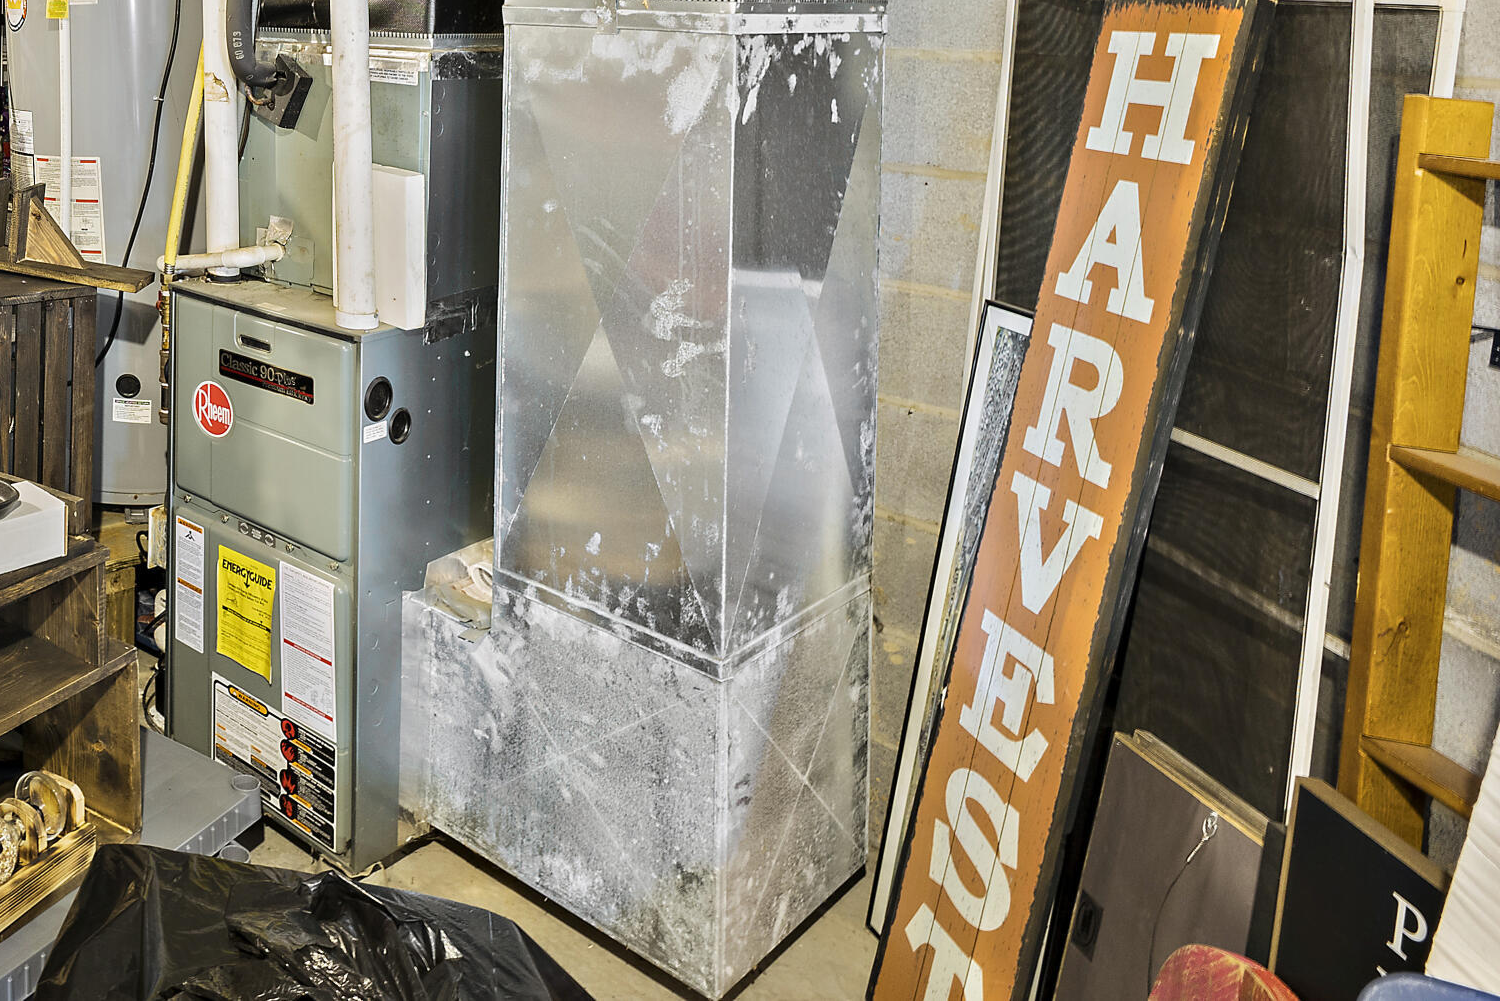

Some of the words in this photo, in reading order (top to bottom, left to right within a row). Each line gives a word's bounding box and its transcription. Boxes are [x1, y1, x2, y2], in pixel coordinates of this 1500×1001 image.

[220, 352, 258, 376] Classic
[260, 364, 275, 382] 90
[198, 382, 232, 427] Rheem
[905, 29, 1220, 1001] HARVEST
